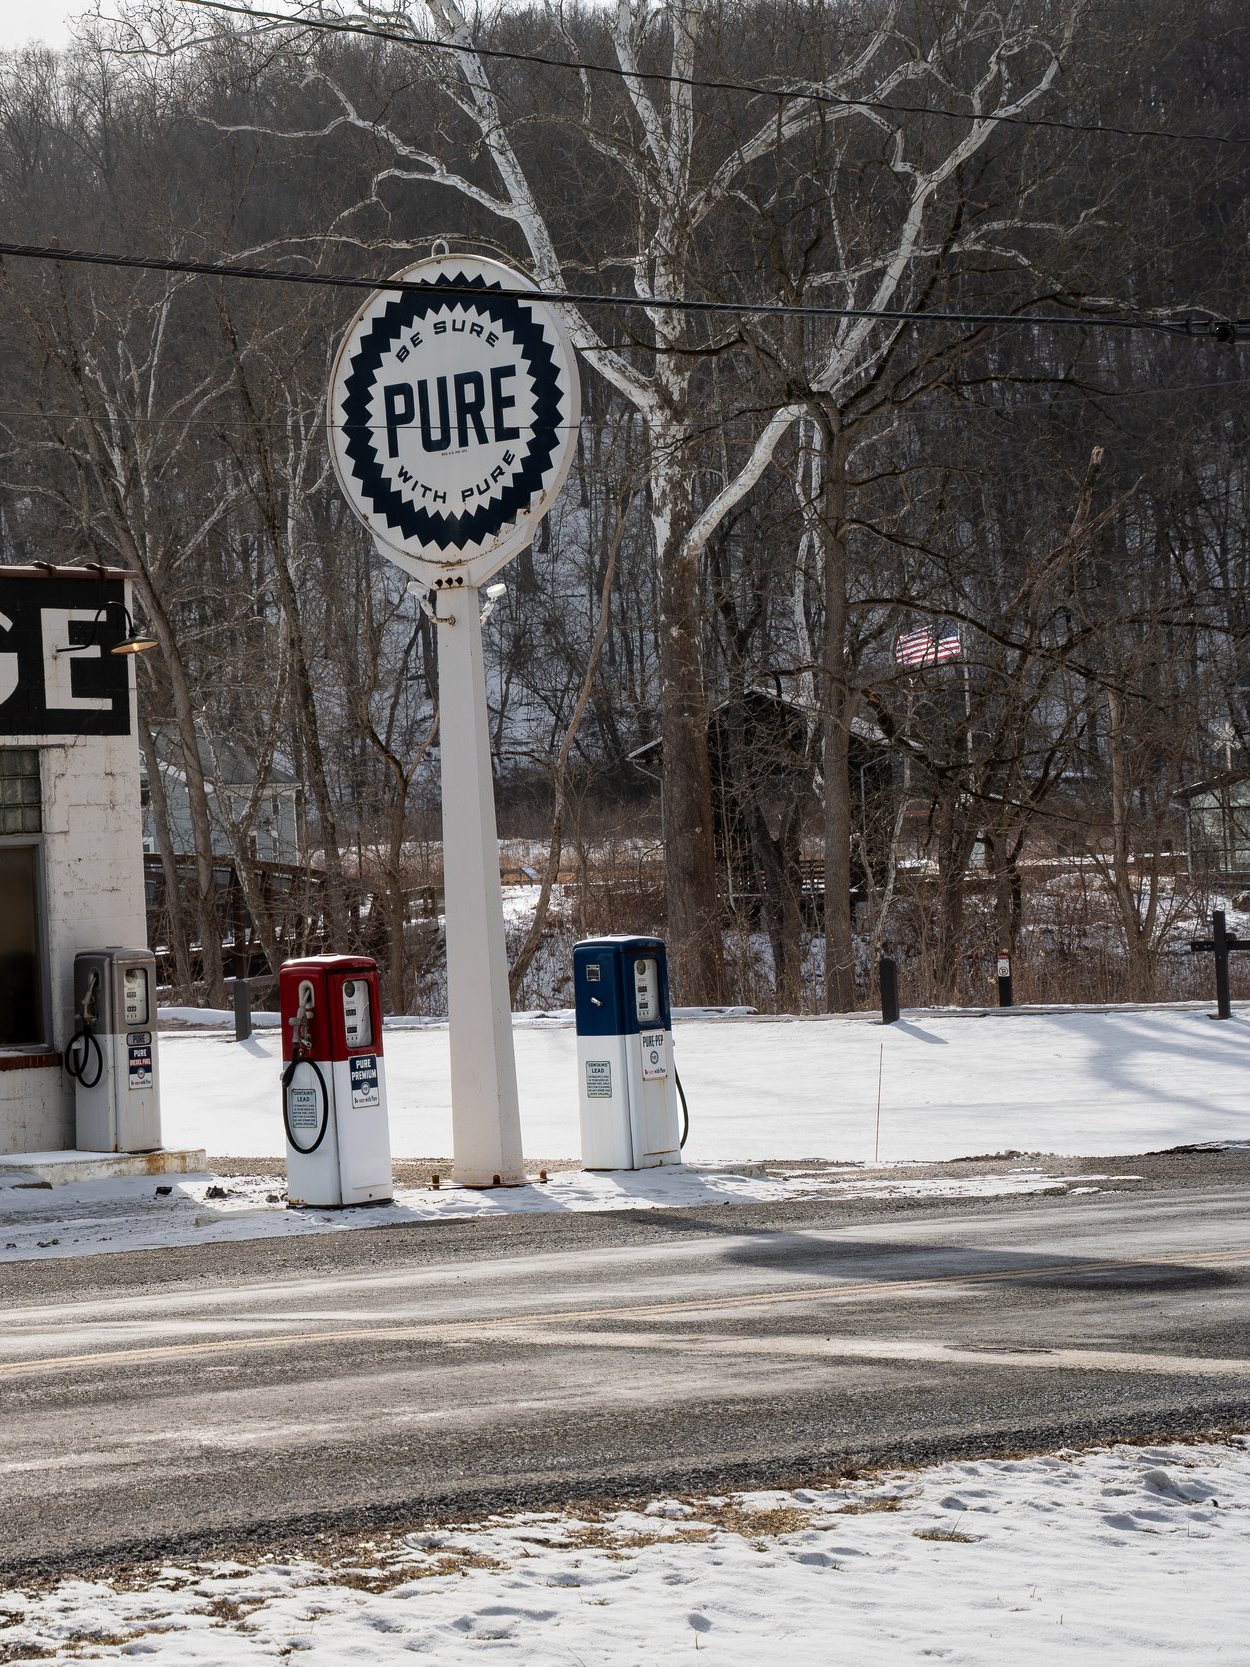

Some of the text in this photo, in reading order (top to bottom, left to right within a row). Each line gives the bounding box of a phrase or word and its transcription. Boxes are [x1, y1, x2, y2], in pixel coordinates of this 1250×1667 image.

[395, 319, 499, 363] BE SURE
[383, 363, 521, 458] PURE
[397, 449, 516, 504] WITH PURE
[133, 1034, 145, 1043] PURE
[134, 1049, 147, 1057] PURE
[356, 1059, 371, 1069] PURE
[352, 1069, 377, 1080] PREMIUM
